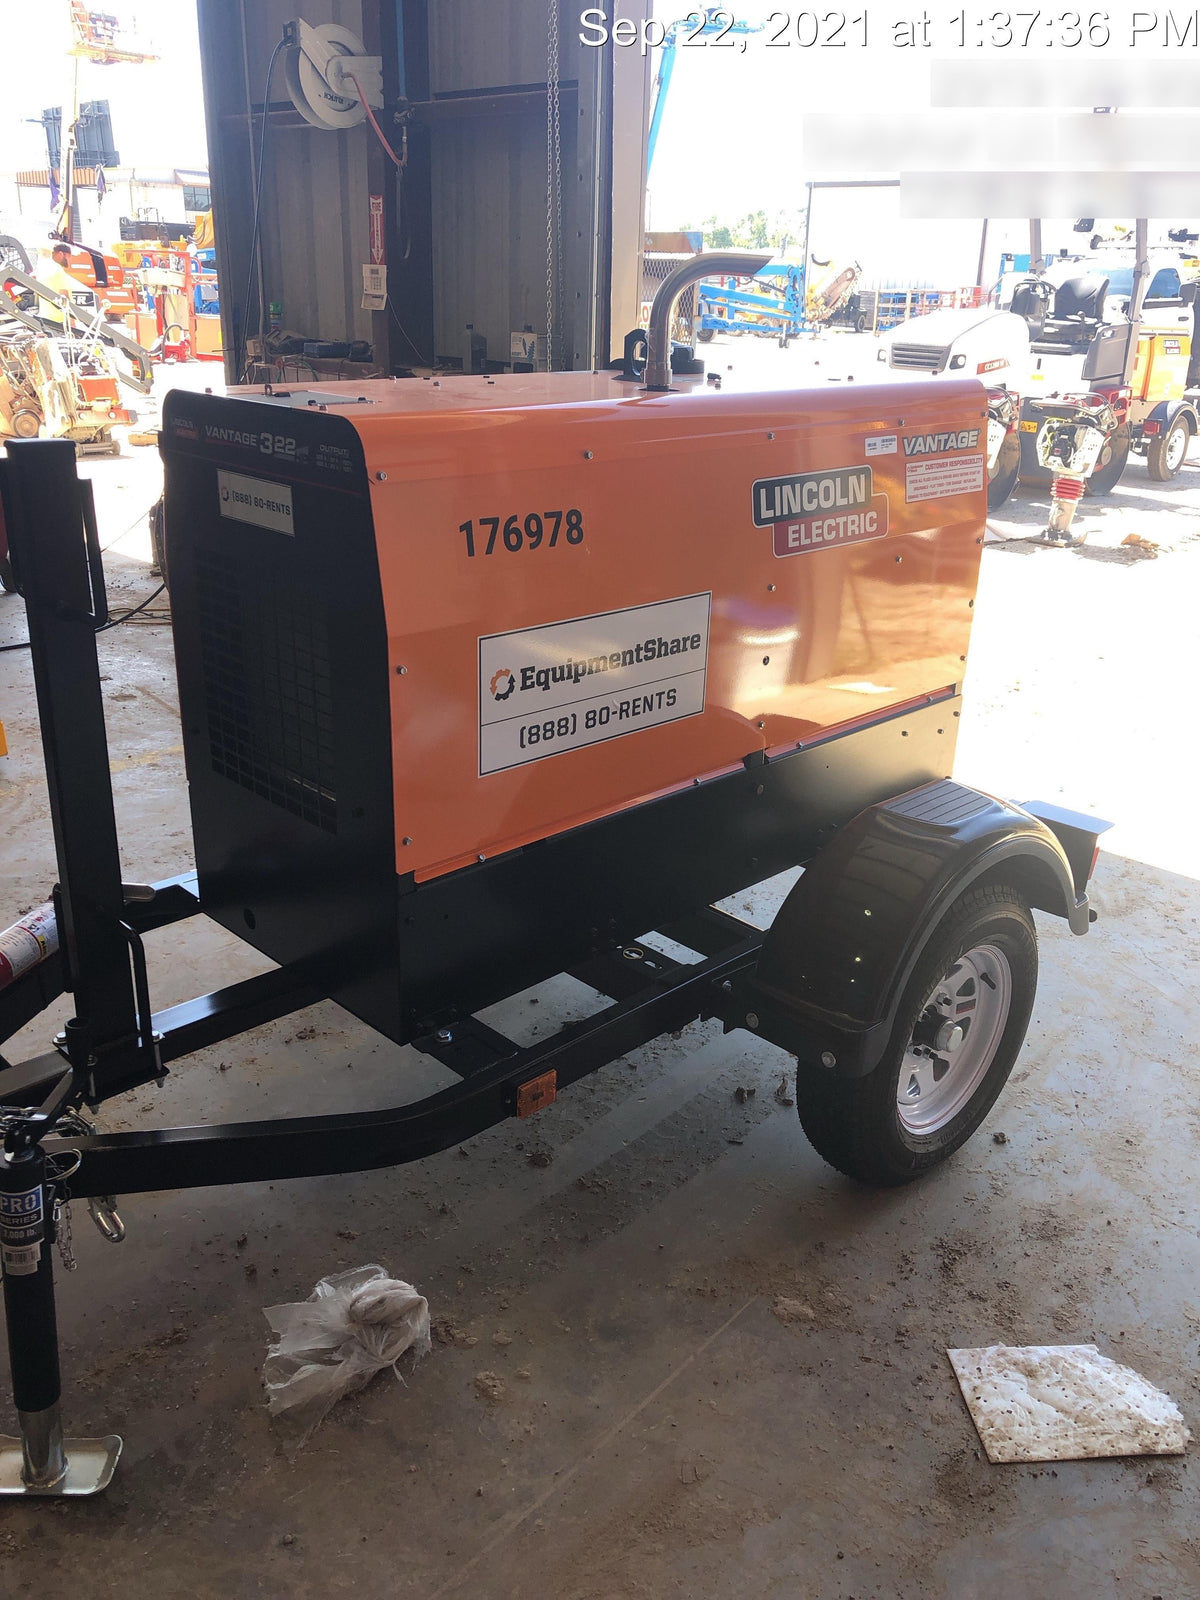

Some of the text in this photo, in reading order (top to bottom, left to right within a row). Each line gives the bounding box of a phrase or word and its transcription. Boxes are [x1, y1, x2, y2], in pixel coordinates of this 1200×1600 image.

[204, 425, 258, 447] VANTAGE
[259, 432, 297, 455] 322
[902, 429, 980, 456] VANTAGE
[232, 490, 291, 516] (888) 80-RENTS
[760, 474, 866, 519] LINCOLN
[459, 509, 584, 557] 176978
[787, 511, 878, 548] ELECTRIC
[520, 633, 701, 691] EquipmentShare
[519, 688, 677, 748] (888) 80-RENTS
[0, 1194, 37, 1213] PRO
[26, 1229, 37, 1237] lb.
